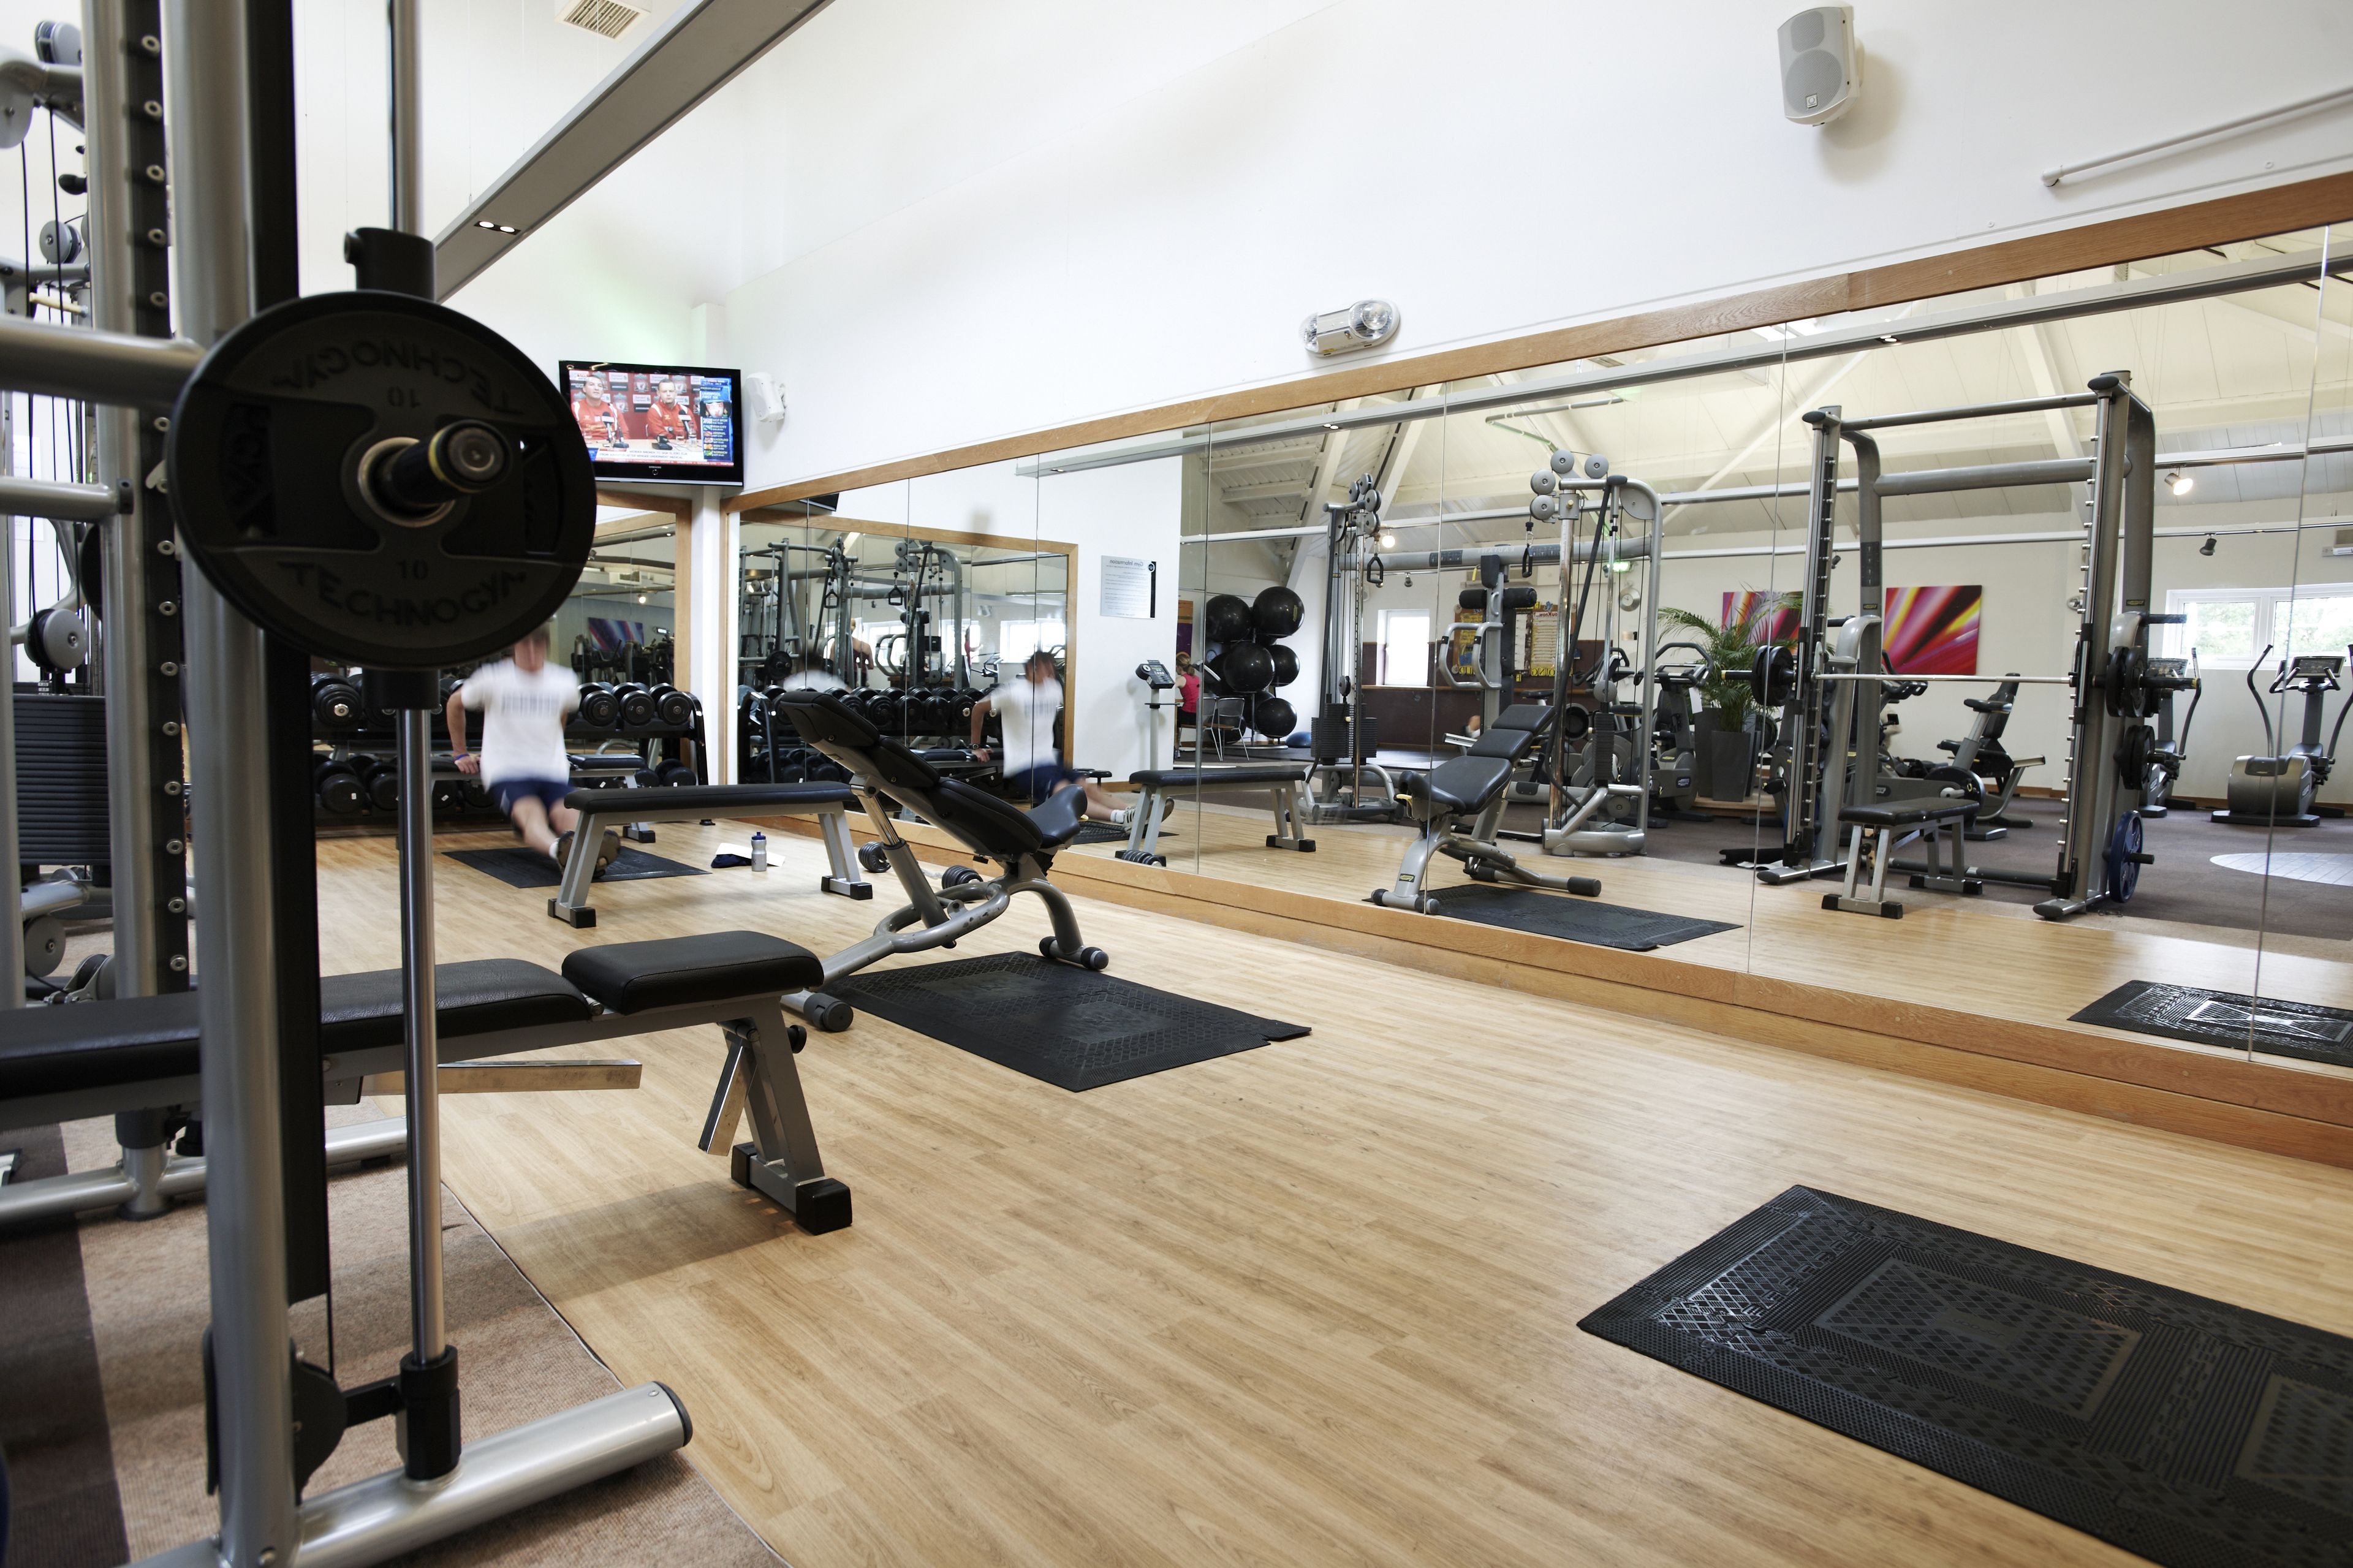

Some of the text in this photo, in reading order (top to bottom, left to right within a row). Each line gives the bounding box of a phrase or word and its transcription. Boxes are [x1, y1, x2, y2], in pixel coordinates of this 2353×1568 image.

[272, 340, 524, 415] TECHNOGYM
[388, 385, 420, 408] 10
[398, 559, 430, 580] 10
[276, 560, 527, 627] TECHNOGYM
